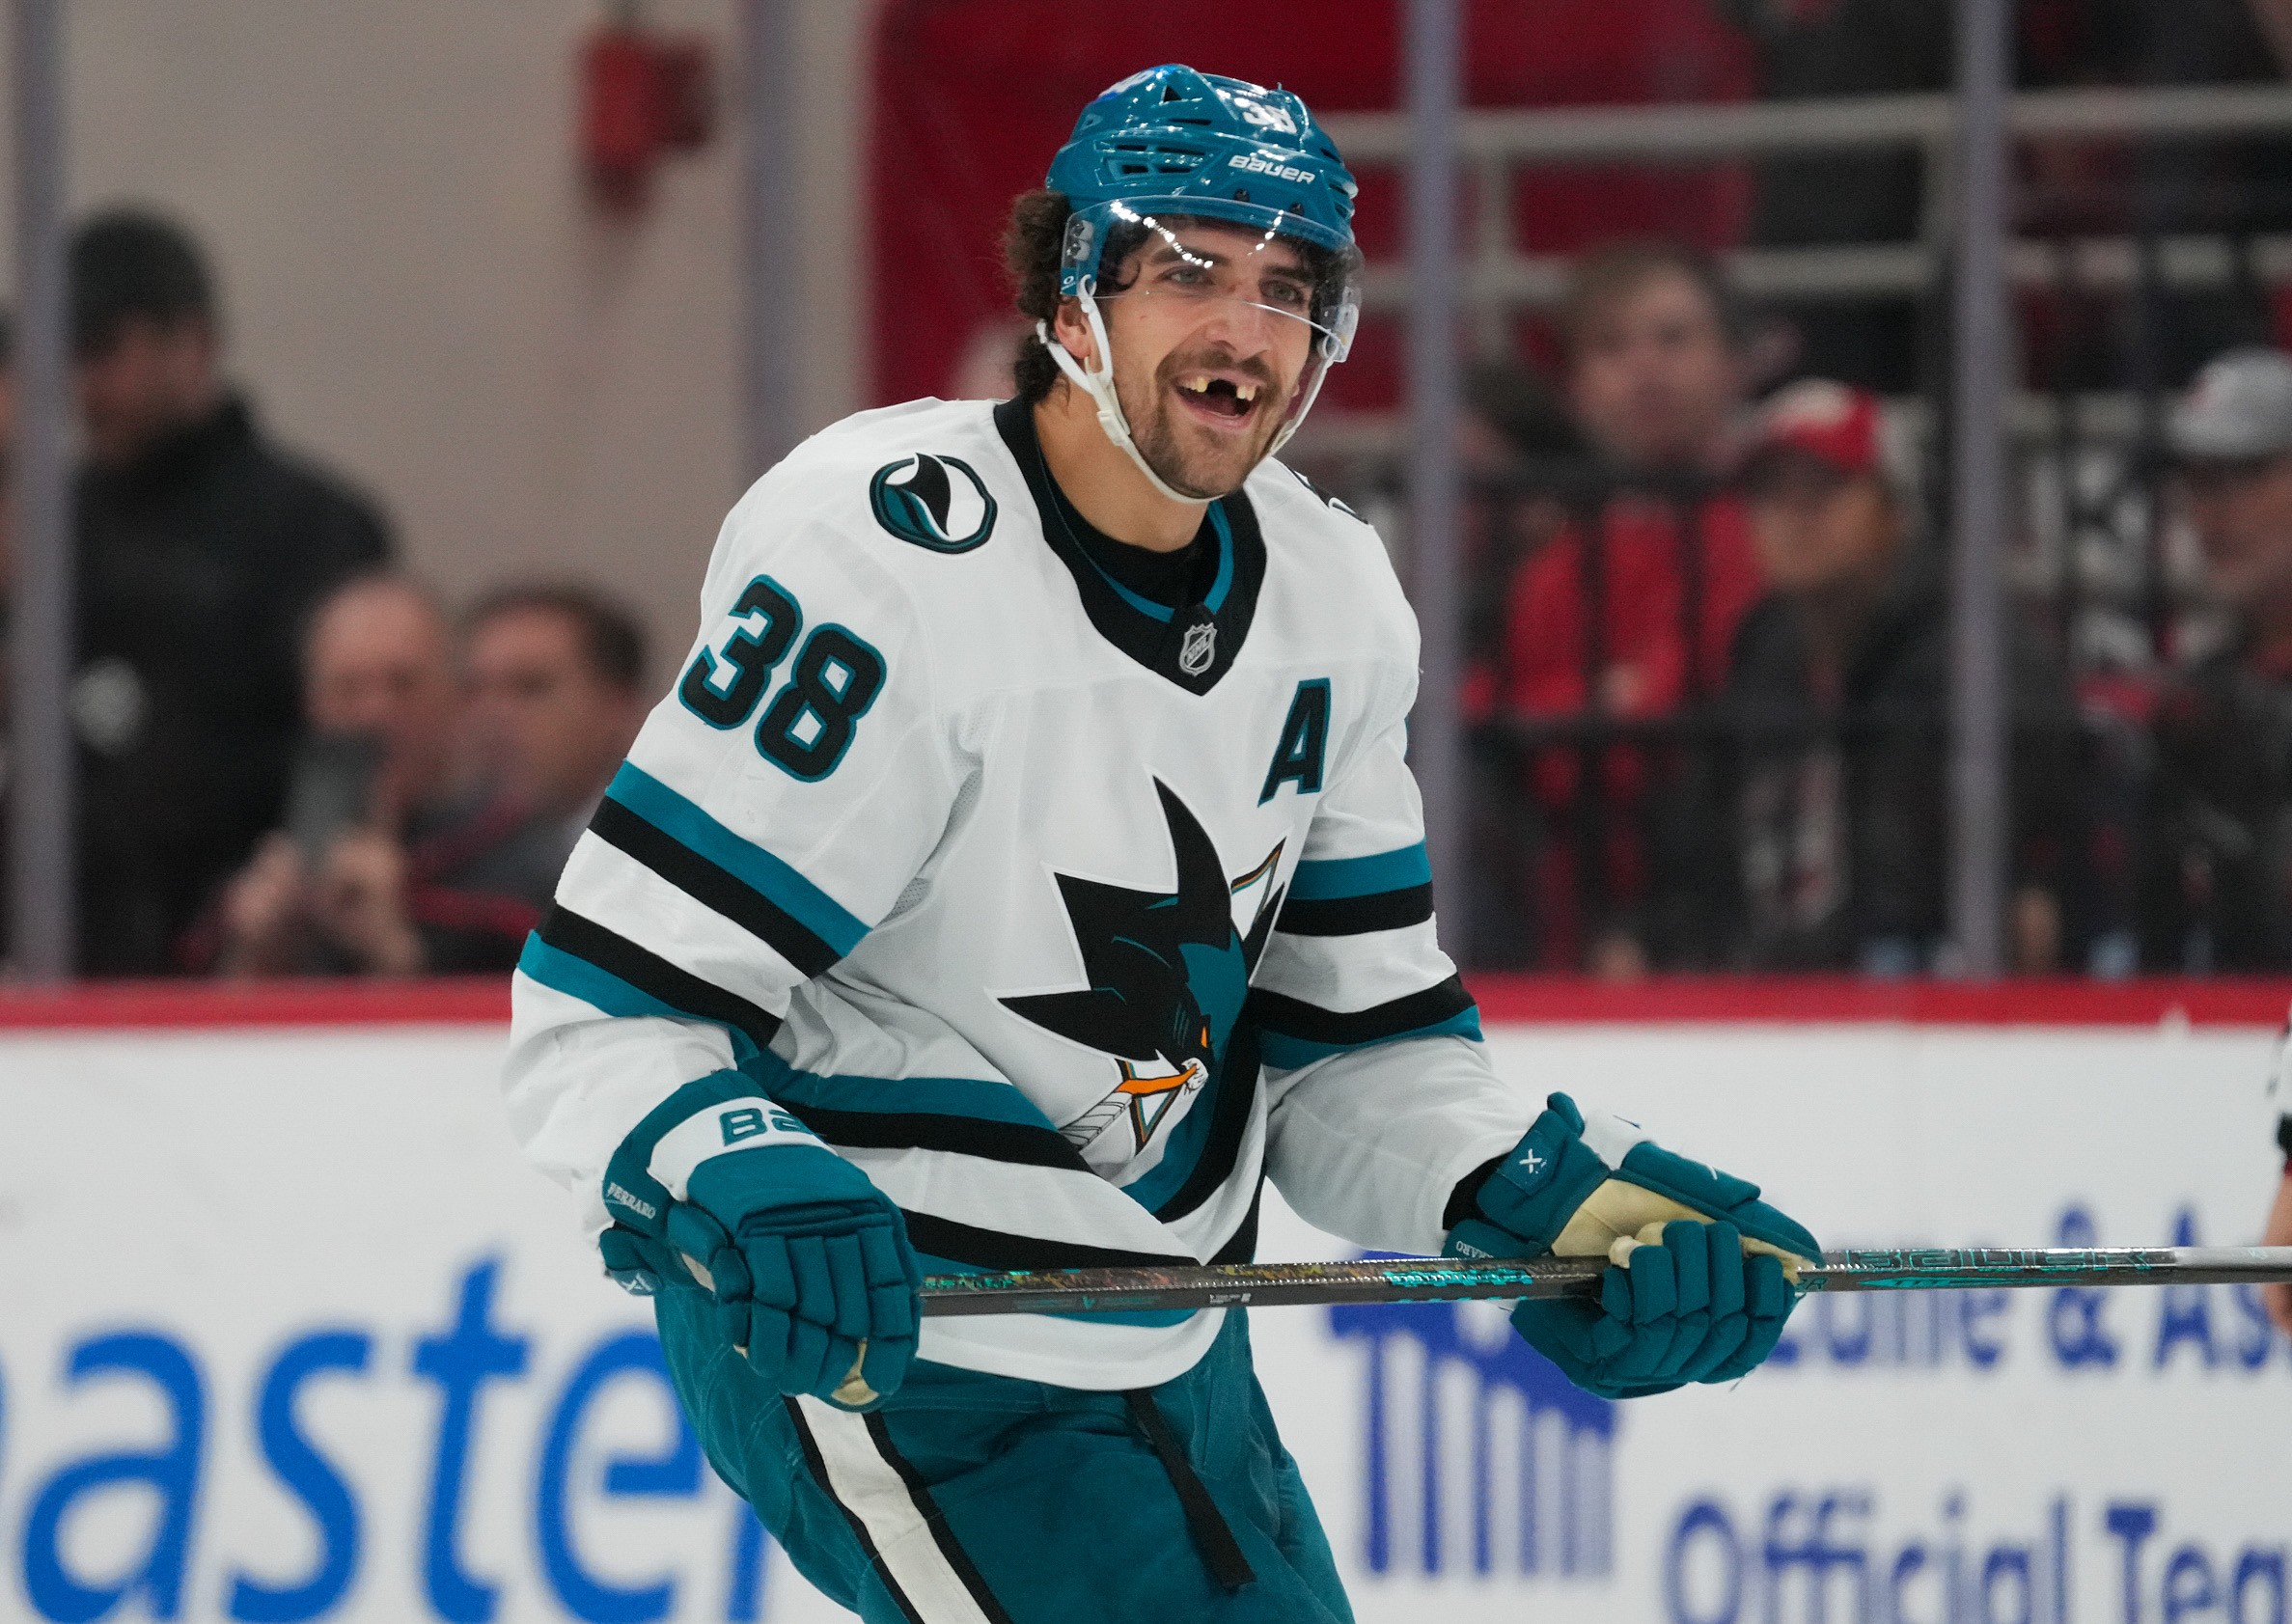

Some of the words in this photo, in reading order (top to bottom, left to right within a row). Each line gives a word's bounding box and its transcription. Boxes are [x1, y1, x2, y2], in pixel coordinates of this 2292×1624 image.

[678, 574, 887, 783] 38
[1257, 676, 1331, 808] A
[0, 1250, 767, 1624] aste
[2104, 1500, 2292, 1624] Tea
